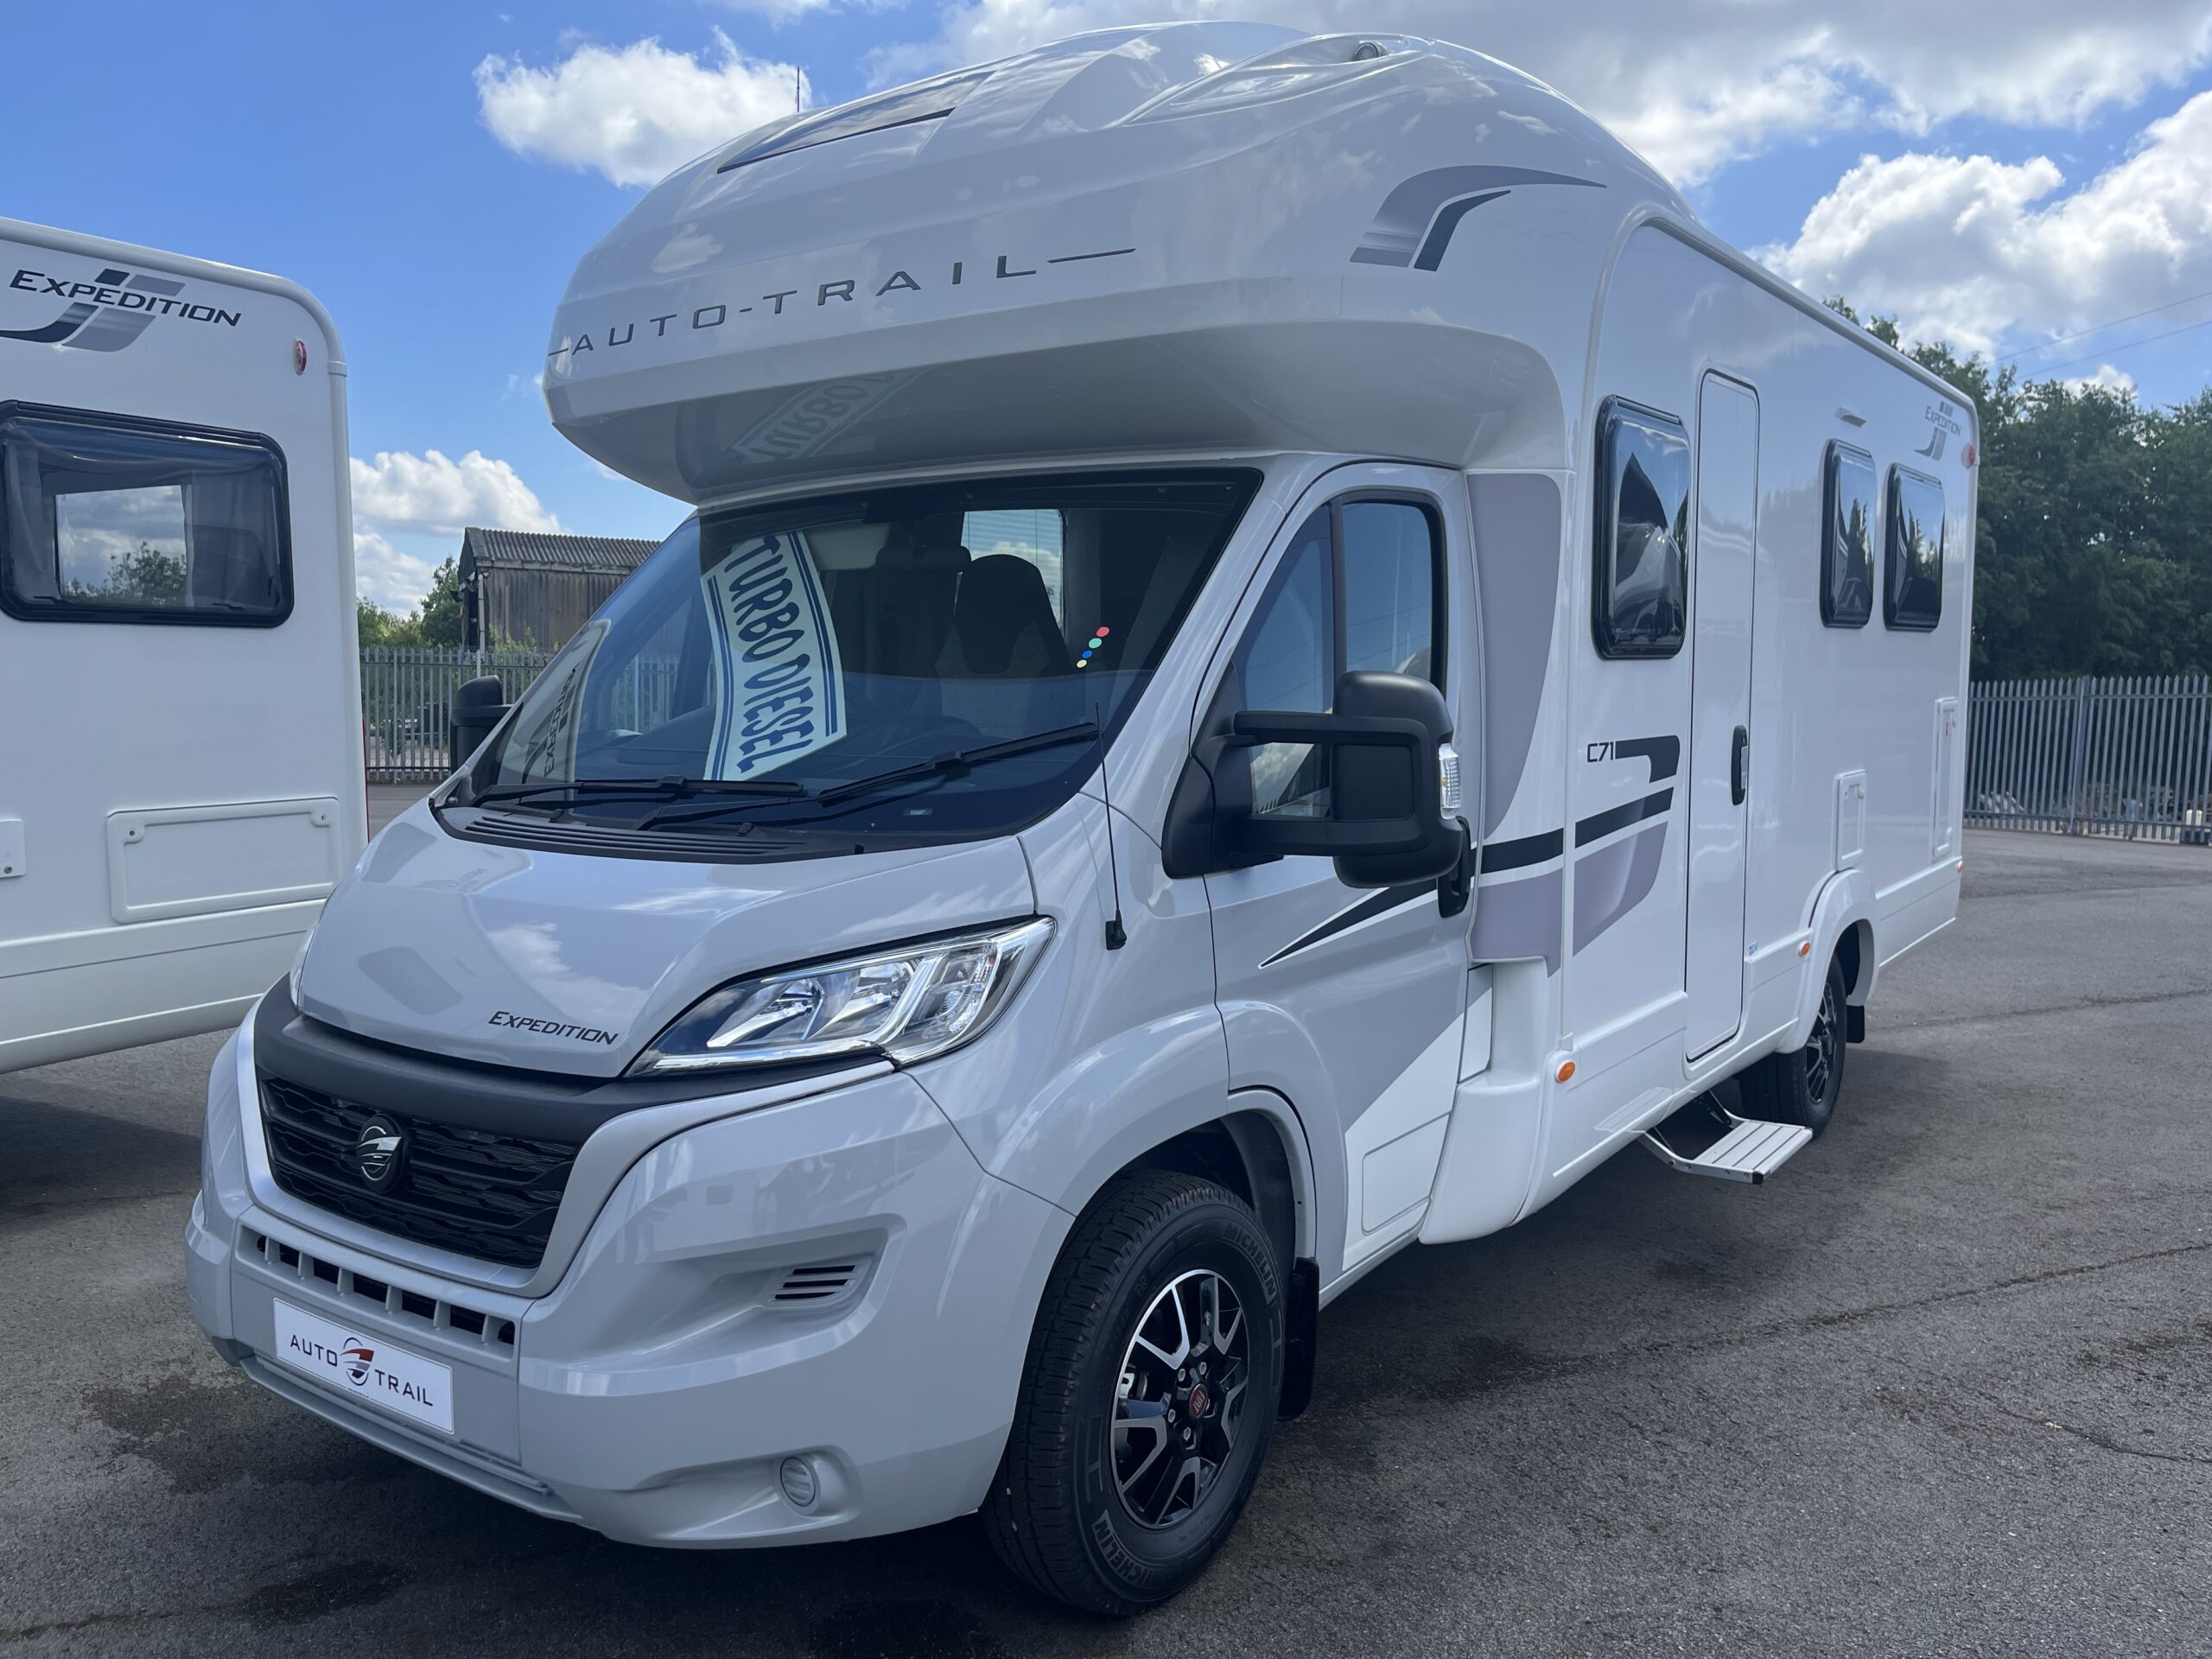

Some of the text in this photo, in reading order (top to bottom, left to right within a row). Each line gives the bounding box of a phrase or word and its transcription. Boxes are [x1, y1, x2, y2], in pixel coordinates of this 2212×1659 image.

[9, 269, 241, 327] EXPEDITION
[572, 255, 1037, 355] AUTO-TRAIL
[724, 535, 815, 773] TURBO DIESEL
[1586, 741, 1614, 763] C71
[488, 1011, 619, 1045] EXPEDITION
[1224, 1222, 1277, 1295] MICHELIN
[290, 1334, 434, 1407] AUTO TRAIL
[1192, 1389, 1205, 1414] FIAT
